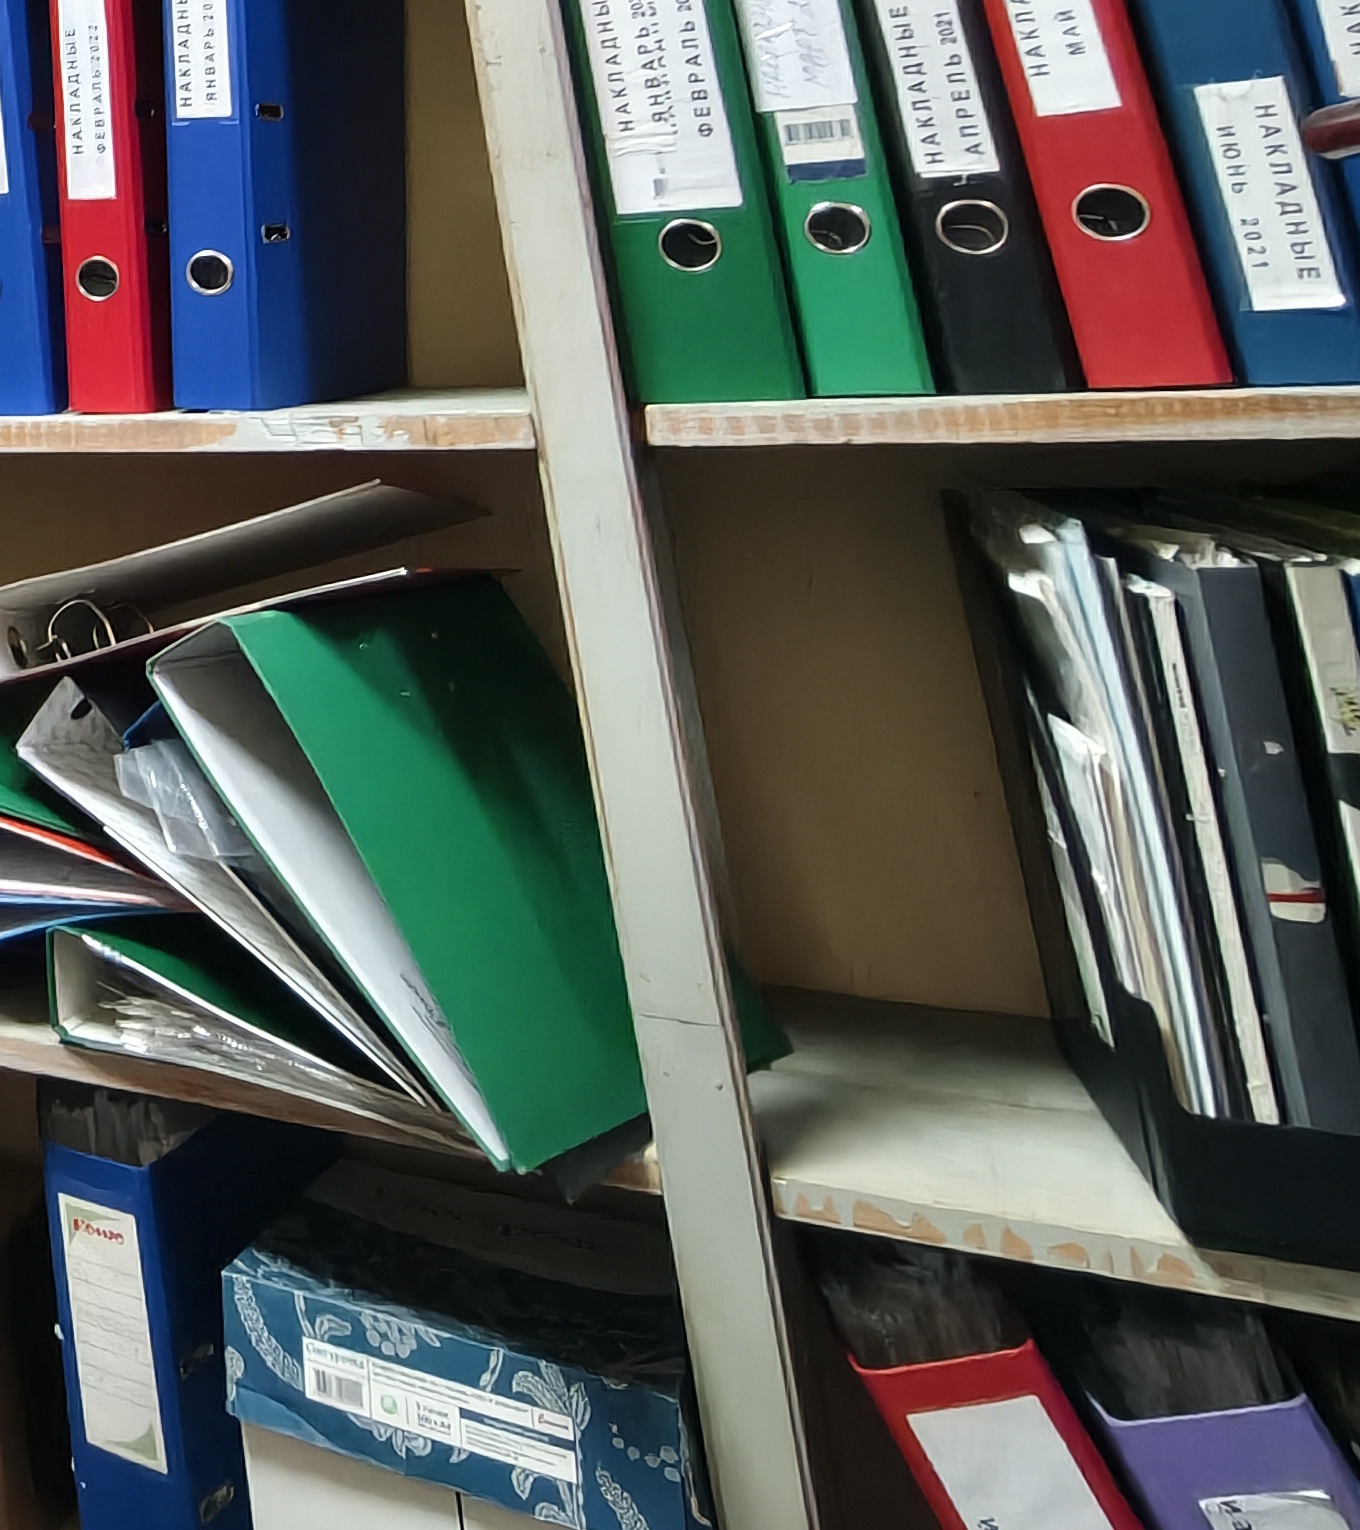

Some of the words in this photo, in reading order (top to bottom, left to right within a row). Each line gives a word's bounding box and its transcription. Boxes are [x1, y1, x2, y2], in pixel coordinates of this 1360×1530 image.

[203, 27, 218, 105] ЯНВАРЬ
[634, 25, 671, 123] ЯНВАРЬ
[680, 20, 714, 138] ФЕВРАЛЬ
[933, 10, 958, 46] 2021
[1053, 8, 1087, 56] МАЙ
[65, 28, 85, 155] НАКЛАДНЫЕ
[92, 69, 107, 154] ФЕВРАЛЬ
[888, 5, 945, 166] НАКЛАДНЫЕ
[944, 53, 986, 157] АПРЕЛЬ
[1215, 124, 1245, 196] ИЮНЬ
[1240, 217, 1270, 269] 2021
[1254, 102, 1322, 281] НАКЛАДНЫЕ
